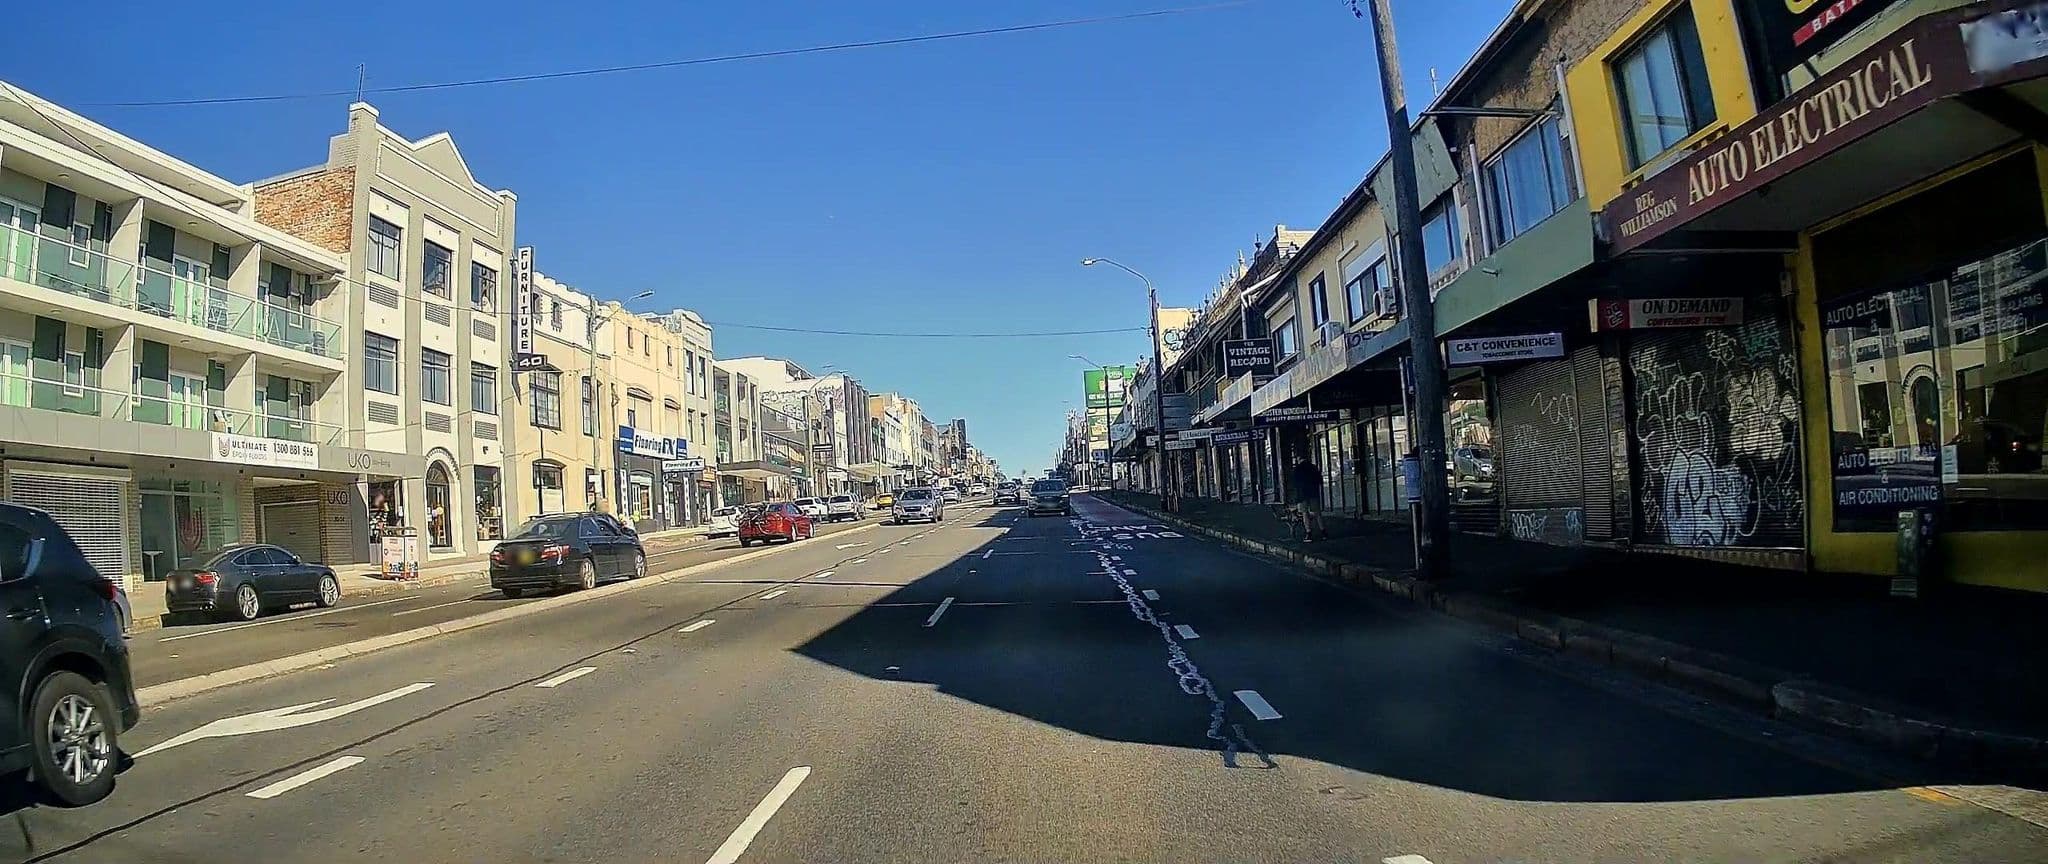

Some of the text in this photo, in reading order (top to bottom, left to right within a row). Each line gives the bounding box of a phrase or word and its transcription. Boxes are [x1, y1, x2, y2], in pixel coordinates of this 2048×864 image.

[1688, 38, 1932, 206] AUTO ELECTRICAL
[1620, 190, 1678, 238] REG WILLIAMSON
[520, 249, 529, 350] FURNITURE
[1642, 299, 1731, 314] ON DEMAND
[1826, 305, 1855, 325] AUTO
[1229, 346, 1271, 356] VINTAGE
[1456, 337, 1556, 353] C&T CONVENIENCE
[519, 356, 543, 368] 40
[1231, 357, 1271, 367] RECORD
[1252, 429, 1265, 440] 35
[232, 440, 268, 452] ULTIMATE
[273, 442, 289, 454] 1300
[289, 444, 300, 455] 881
[348, 453, 371, 470] UKO
[1838, 452, 1866, 469] AUTO
[327, 490, 348, 505] UKO
[1839, 485, 1938, 505] AIR CONDITIONING
